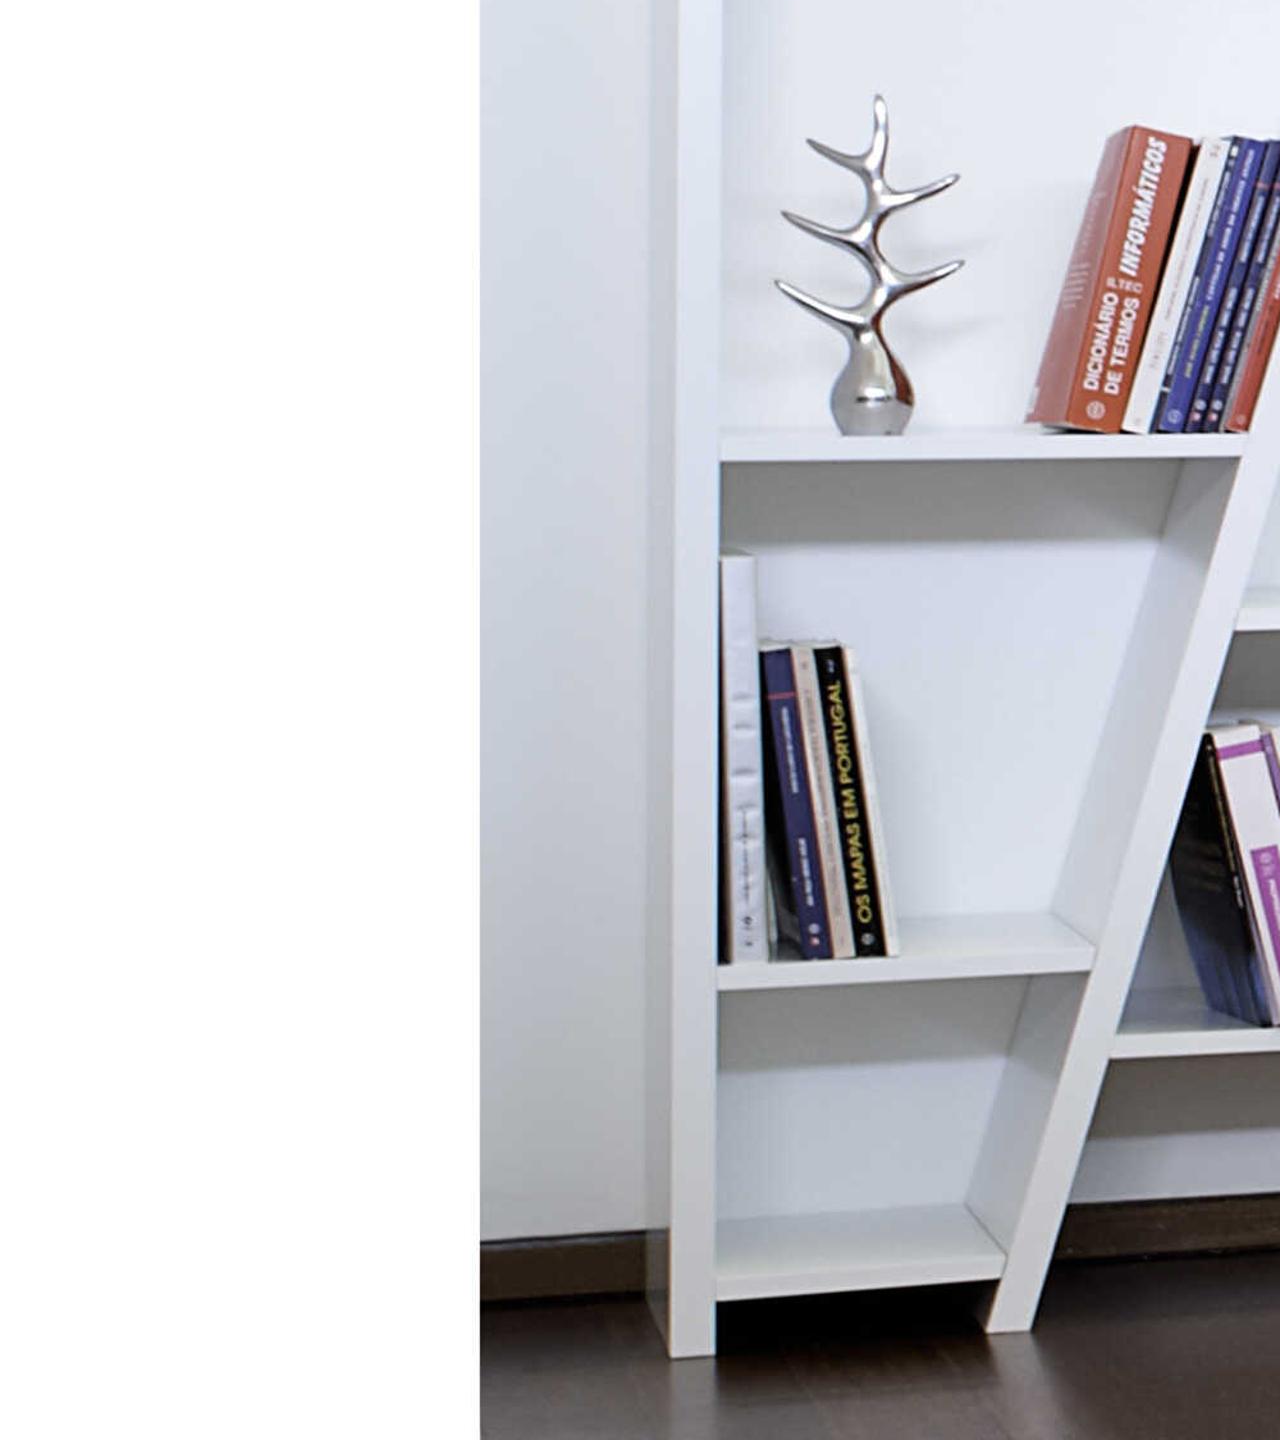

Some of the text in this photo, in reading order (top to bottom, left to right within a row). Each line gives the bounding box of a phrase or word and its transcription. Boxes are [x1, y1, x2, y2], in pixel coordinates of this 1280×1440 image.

[1118, 136, 1167, 277] INFORMÁTICOS
[1083, 291, 1119, 391] DICIONÁRIO
[1104, 297, 1140, 395] DE TERMOS
[827, 680, 872, 923] OS MAPAS EM PORTUGAL
